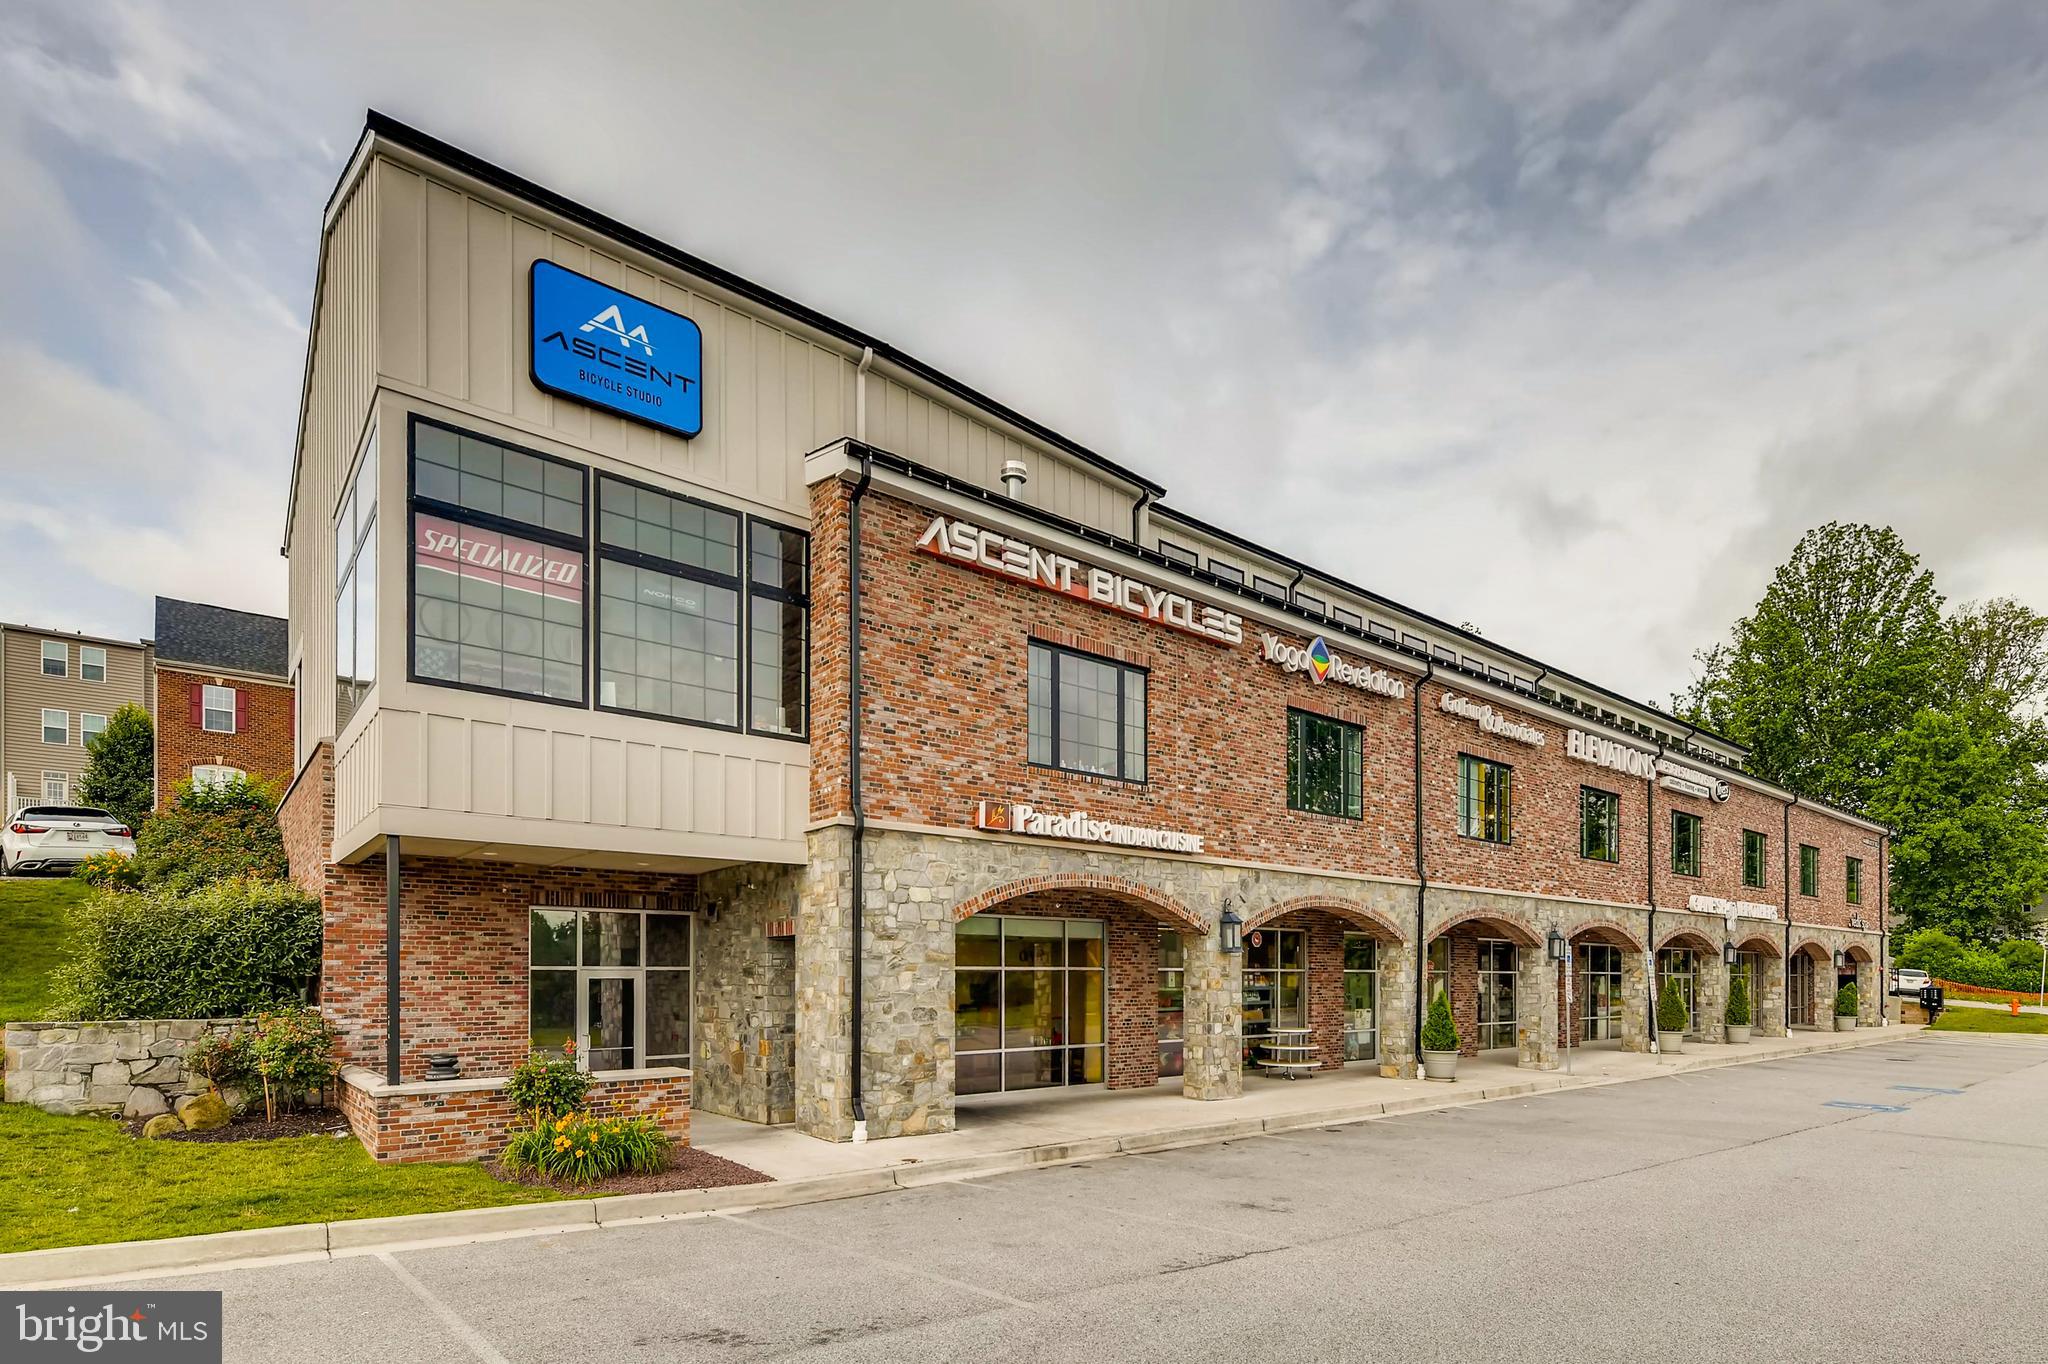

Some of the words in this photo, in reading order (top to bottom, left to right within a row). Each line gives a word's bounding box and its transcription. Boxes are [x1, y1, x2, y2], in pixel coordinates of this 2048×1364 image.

[543, 331, 696, 393] ASCENT
[579, 369, 623, 393] BICYCLE
[626, 386, 663, 407] STUDIO
[418, 529, 578, 585] SPECIALIZED
[915, 516, 1079, 591] ASCENT
[1088, 567, 1243, 644] BICYCLES
[1260, 632, 1310, 673] Yoga
[1328, 654, 1406, 700] Revelation
[1012, 804, 1112, 843] Paradise
[1112, 824, 1157, 848] INDIAN
[1157, 830, 1205, 853] CUISINE
